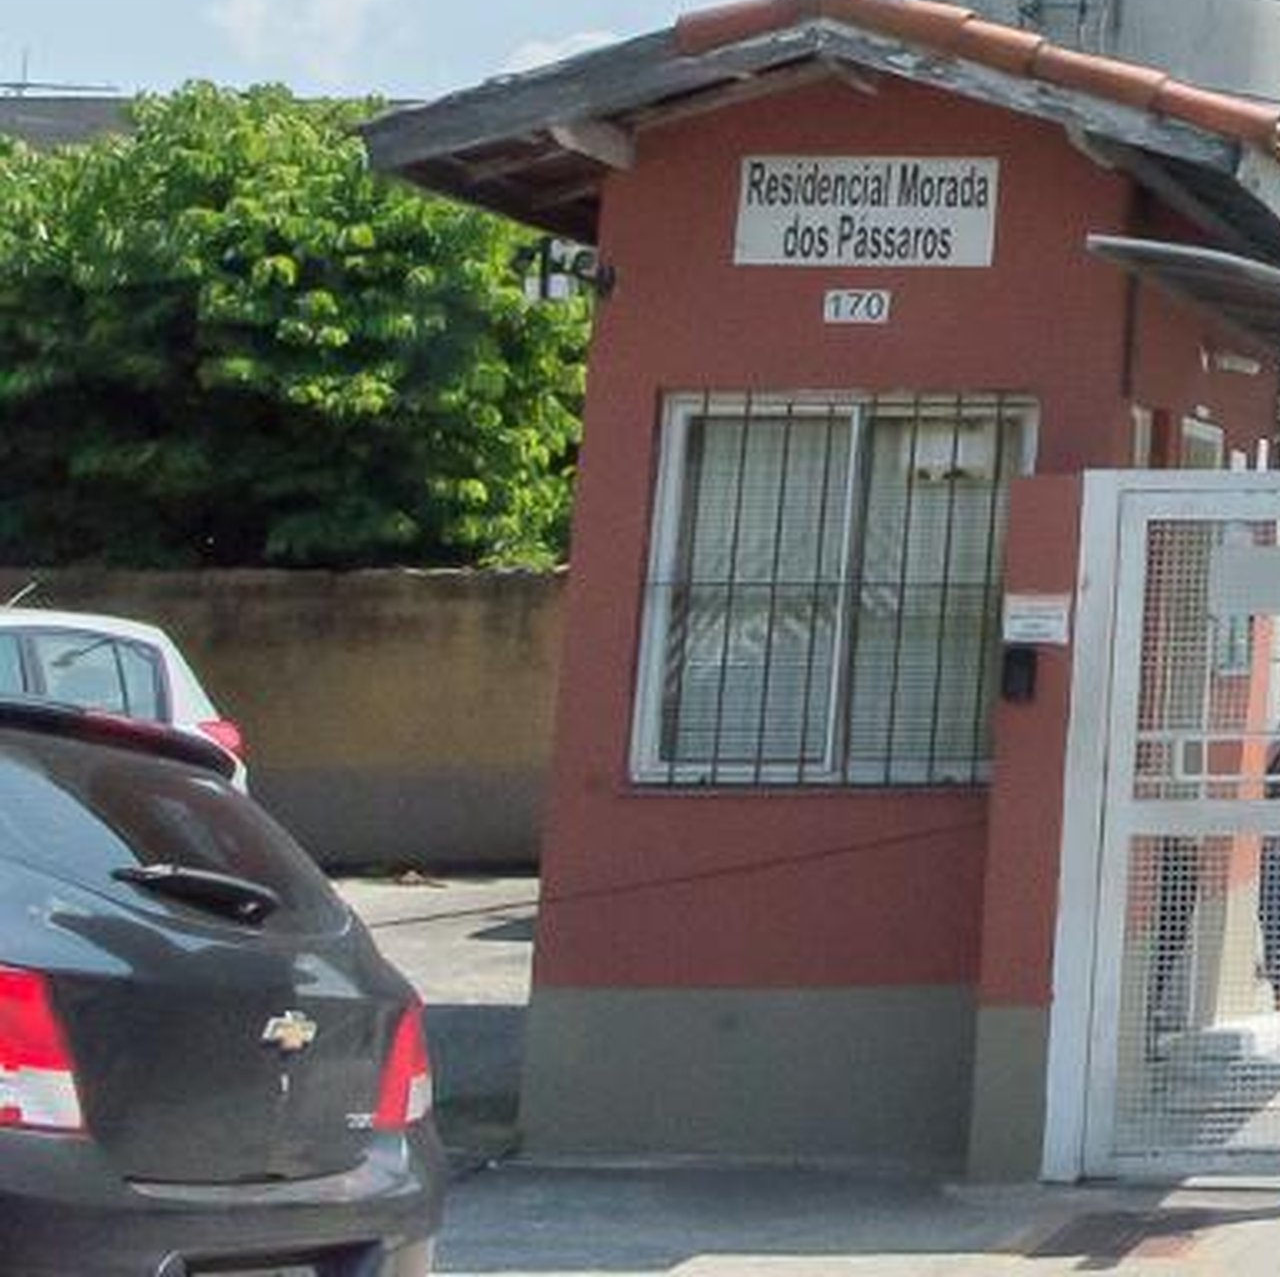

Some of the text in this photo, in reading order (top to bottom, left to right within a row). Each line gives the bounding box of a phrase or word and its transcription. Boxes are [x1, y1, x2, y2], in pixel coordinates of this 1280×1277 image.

[747, 162, 988, 207] Residencial Morada
[784, 213, 952, 259] dos Pássaros
[829, 293, 885, 319] 170
